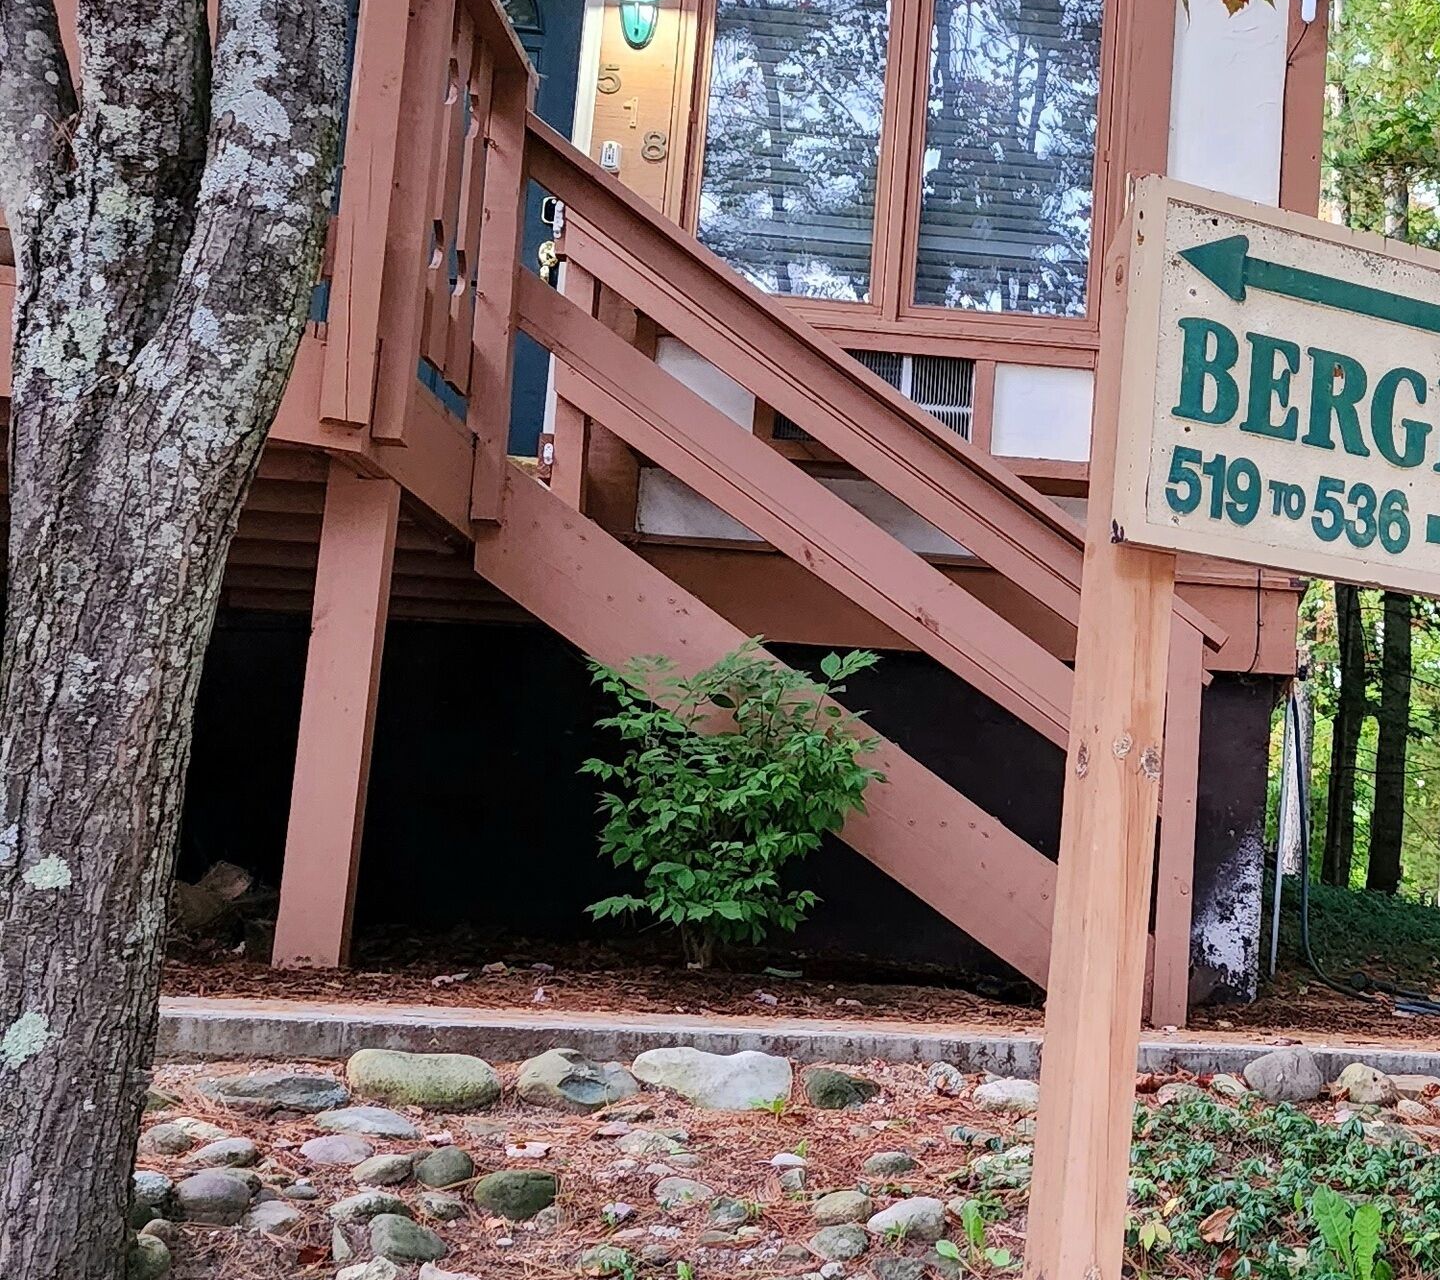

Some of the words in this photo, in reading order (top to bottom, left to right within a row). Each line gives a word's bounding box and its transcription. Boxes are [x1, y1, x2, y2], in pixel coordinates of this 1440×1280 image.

[597, 64, 667, 161] 518
[1165, 446, 1261, 526] 519
[1269, 480, 1306, 520] TO
[1311, 476, 1411, 554] 536
